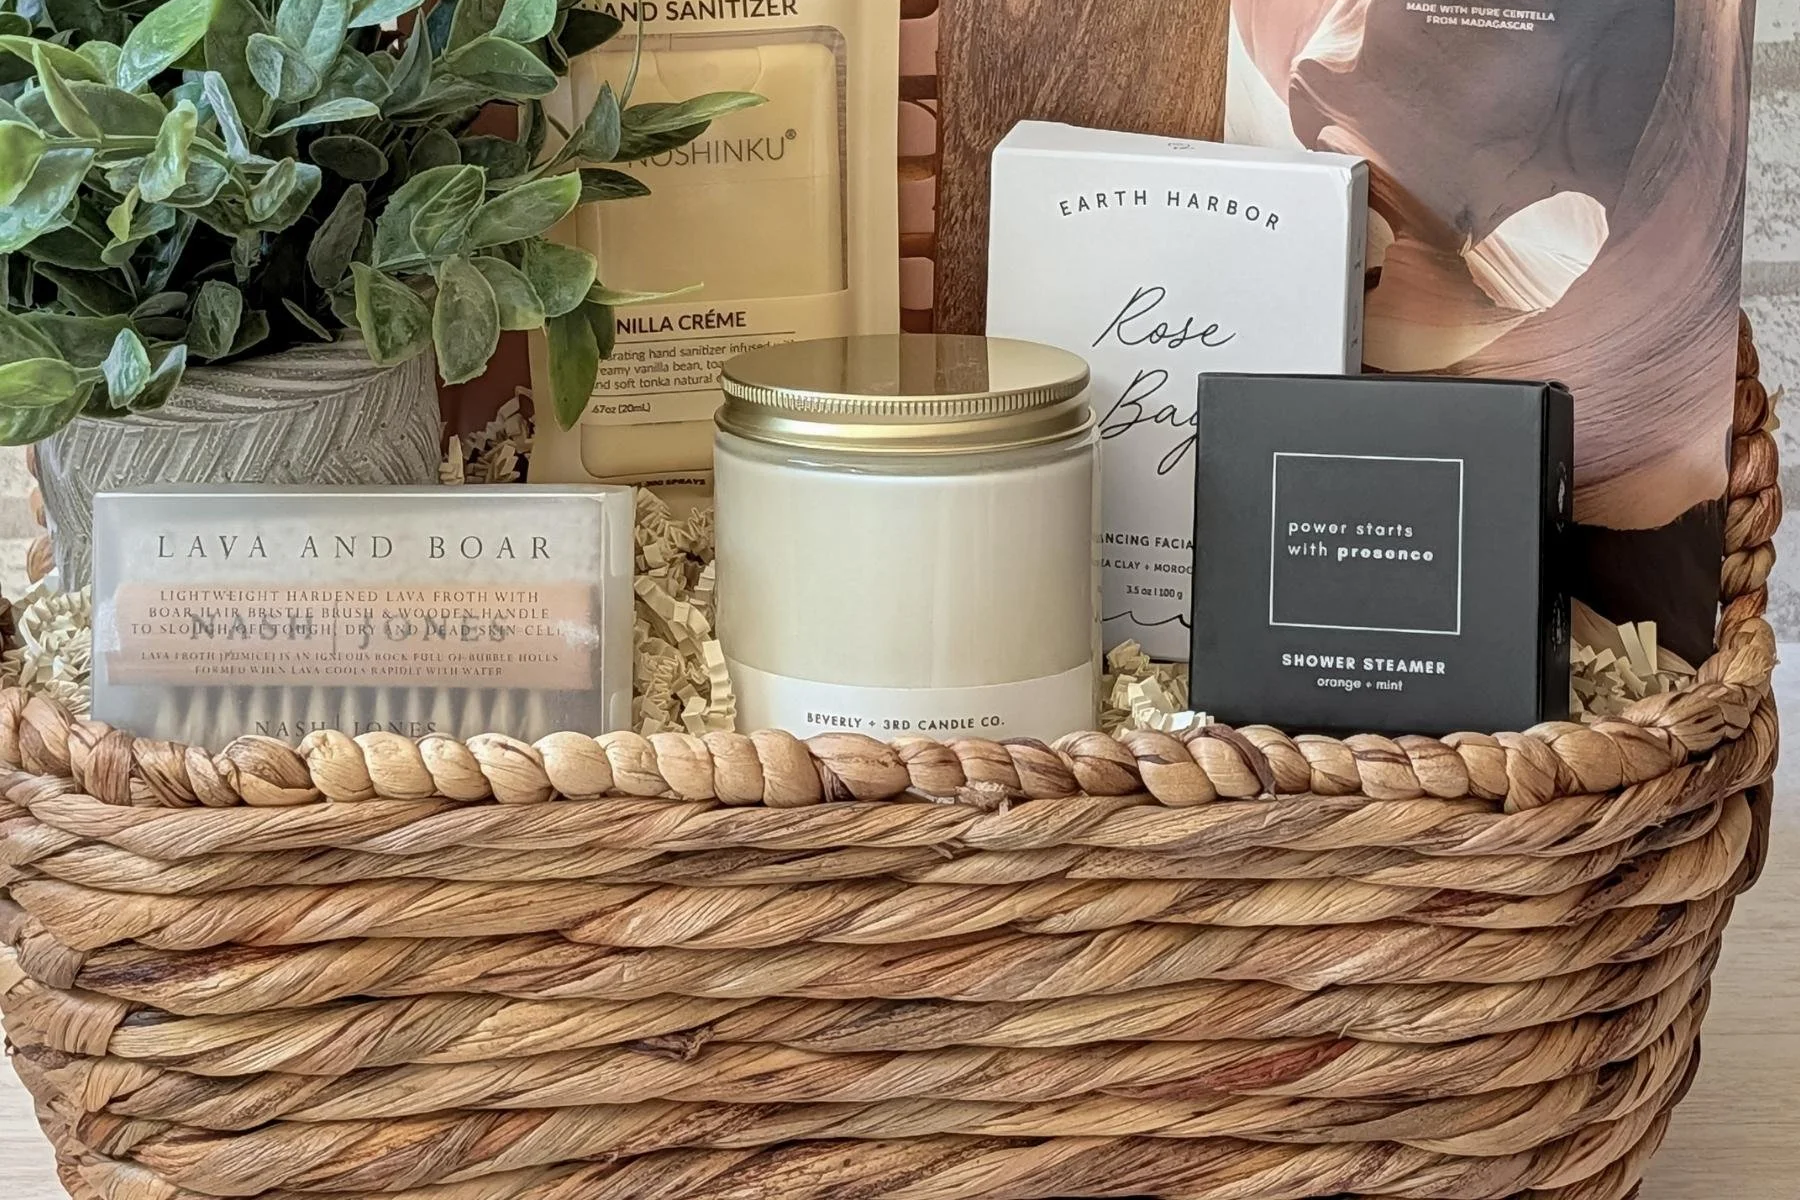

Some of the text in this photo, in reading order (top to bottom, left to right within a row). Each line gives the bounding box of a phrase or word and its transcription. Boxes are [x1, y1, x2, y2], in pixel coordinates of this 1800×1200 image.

[582, 0, 658, 23] AND
[1406, 2, 1556, 22] MADE WITH PURE CENTELLA
[1426, 15, 1535, 31] FROM MADAGASCAR
[1060, 190, 1281, 231] EARTH HARBOR
[616, 309, 747, 335] NILLA CRÉME
[1092, 286, 1237, 349] Rose
[602, 350, 646, 363] rating
[649, 347, 676, 359] hand
[680, 344, 726, 356] sanitizer
[634, 362, 669, 374] vanilla
[614, 377, 636, 390] soft
[640, 376, 671, 388] tonka
[674, 373, 713, 386] natural
[1288, 522, 1414, 538] power starts
[158, 534, 553, 561] LAVA AND BOAR
[1154, 537, 1194, 550] FACIA
[1288, 541, 1434, 562] with presence
[1114, 560, 1141, 570] CLAY
[1153, 563, 1193, 575] MOROC
[160, 590, 539, 603] LIGHTWEIGHT HARDENED LAVA FROTH WITH
[1141, 588, 1153, 596] oz
[1159, 588, 1175, 598] 100
[1176, 591, 1183, 600] g
[149, 607, 193, 618] BOAR
[200, 607, 240, 618] HAIR
[248, 607, 313, 619] BRISTLE
[322, 608, 374, 619] BRUSH
[398, 608, 473, 619] WOODEN
[482, 608, 550, 619] HANDLE
[131, 623, 152, 635] TO
[345, 624, 376, 635] DRY
[141, 651, 169, 661] LAVA
[375, 652, 408, 661] ROCK
[413, 652, 443, 662] FULL
[468, 653, 513, 663] BUBBLE
[1282, 653, 1446, 675] SHOWER STEAMER
[291, 666, 320, 675] LAVA
[1317, 677, 1361, 691] orange
[1376, 679, 1403, 692] mint
[807, 712, 862, 729] BEVERLY
[883, 718, 911, 730] 3RD
[918, 717, 975, 731] CANDLE
[980, 715, 1005, 727] CO.
